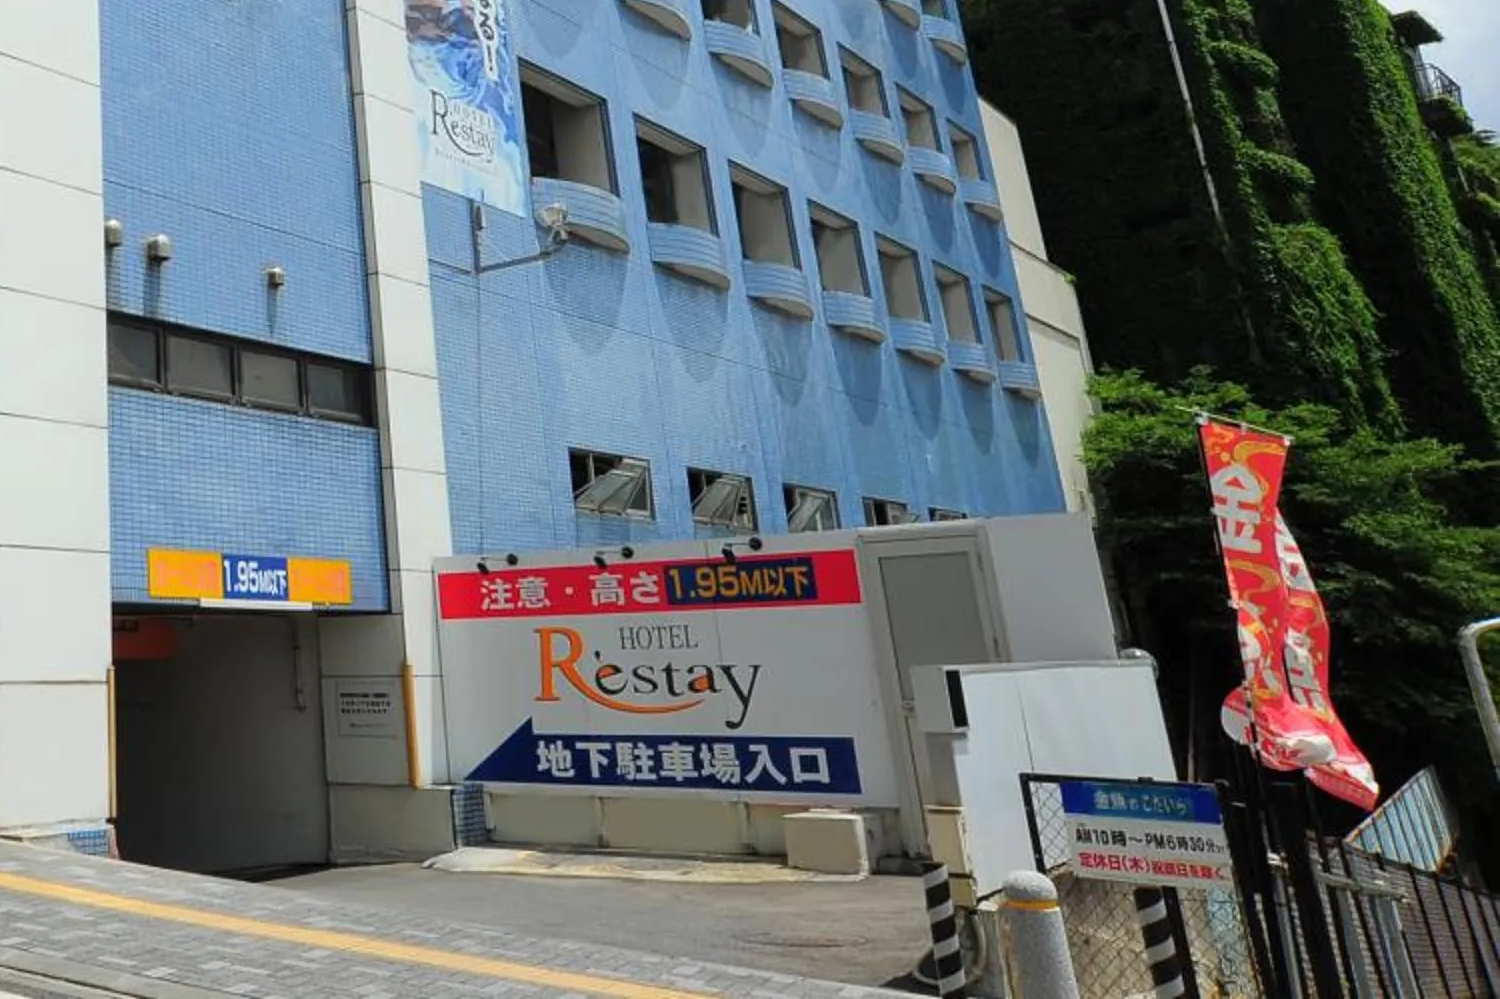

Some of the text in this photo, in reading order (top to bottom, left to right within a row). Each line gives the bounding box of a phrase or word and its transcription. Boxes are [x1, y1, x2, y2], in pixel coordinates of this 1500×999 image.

[480, 564, 809, 611] 注意・高さ 1.95M以下
[618, 623, 700, 651] HOTEL
[536, 739, 832, 786] 地下駐車場入口
